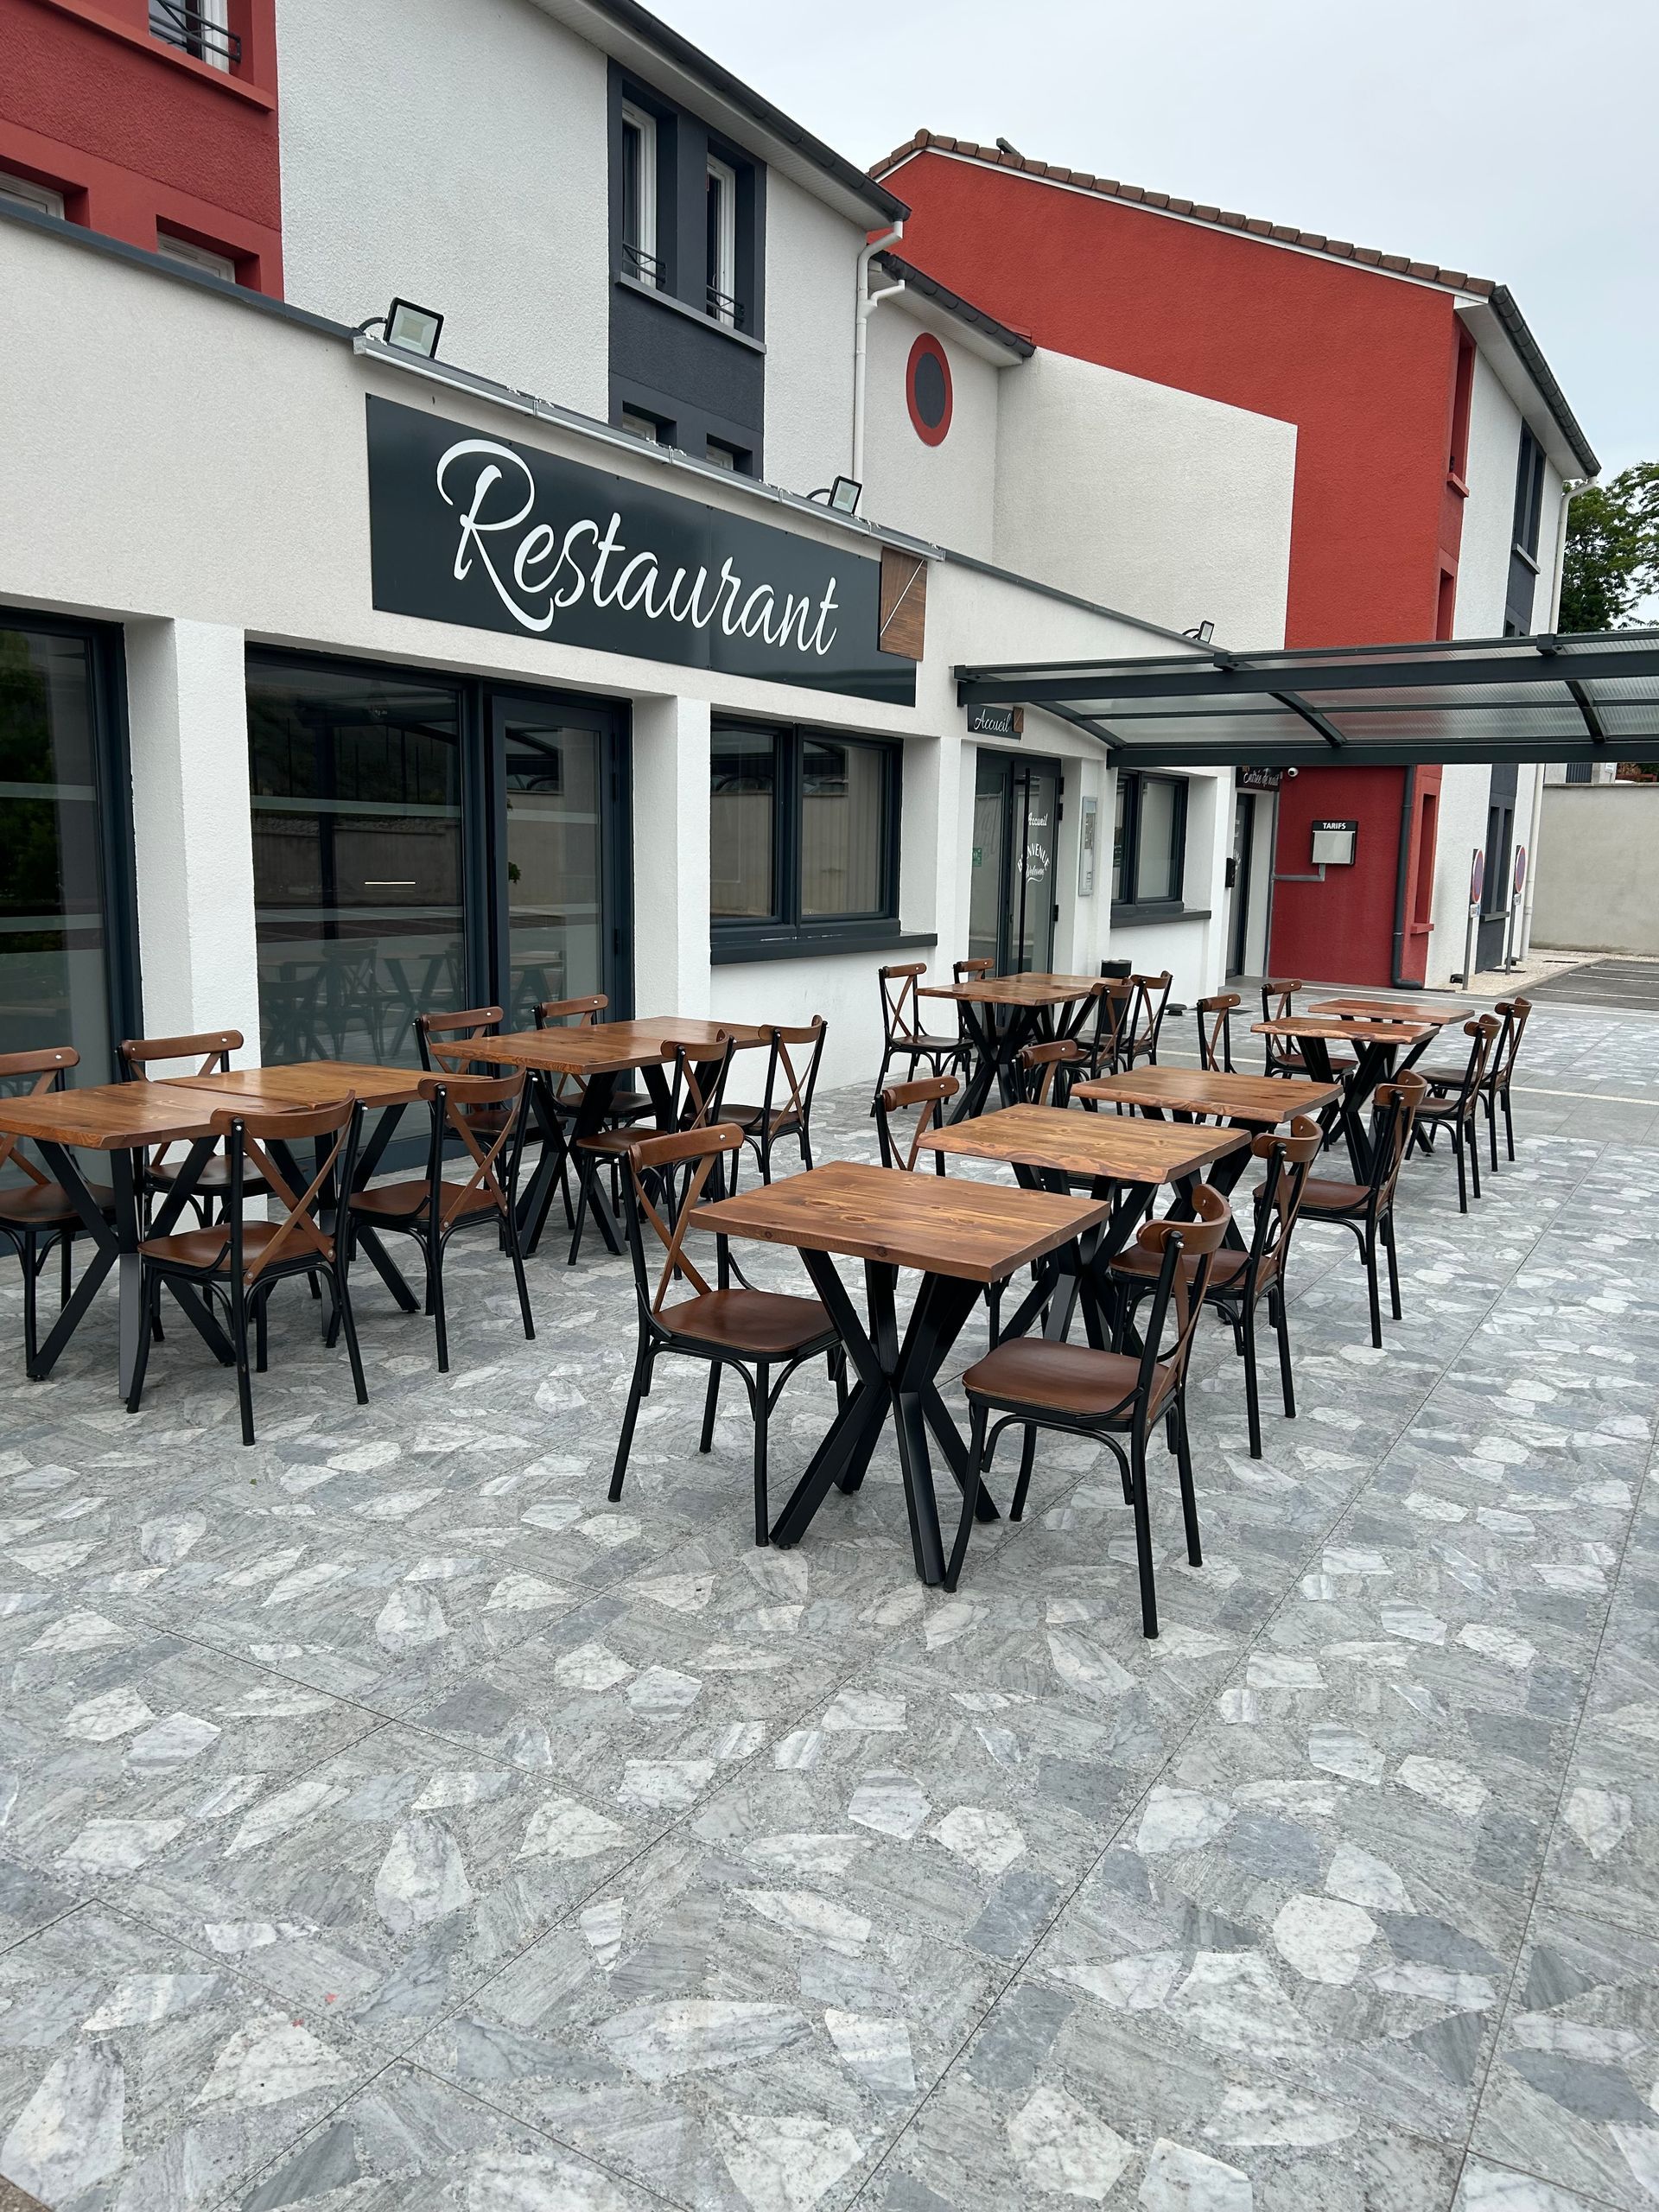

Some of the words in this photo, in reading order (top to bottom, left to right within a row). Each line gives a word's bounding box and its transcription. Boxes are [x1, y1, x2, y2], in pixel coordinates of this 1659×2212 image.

[436, 439, 839, 657] Restaurant
[974, 709, 1011, 733] Accueil
[1017, 842, 1050, 873] BNVENUE
